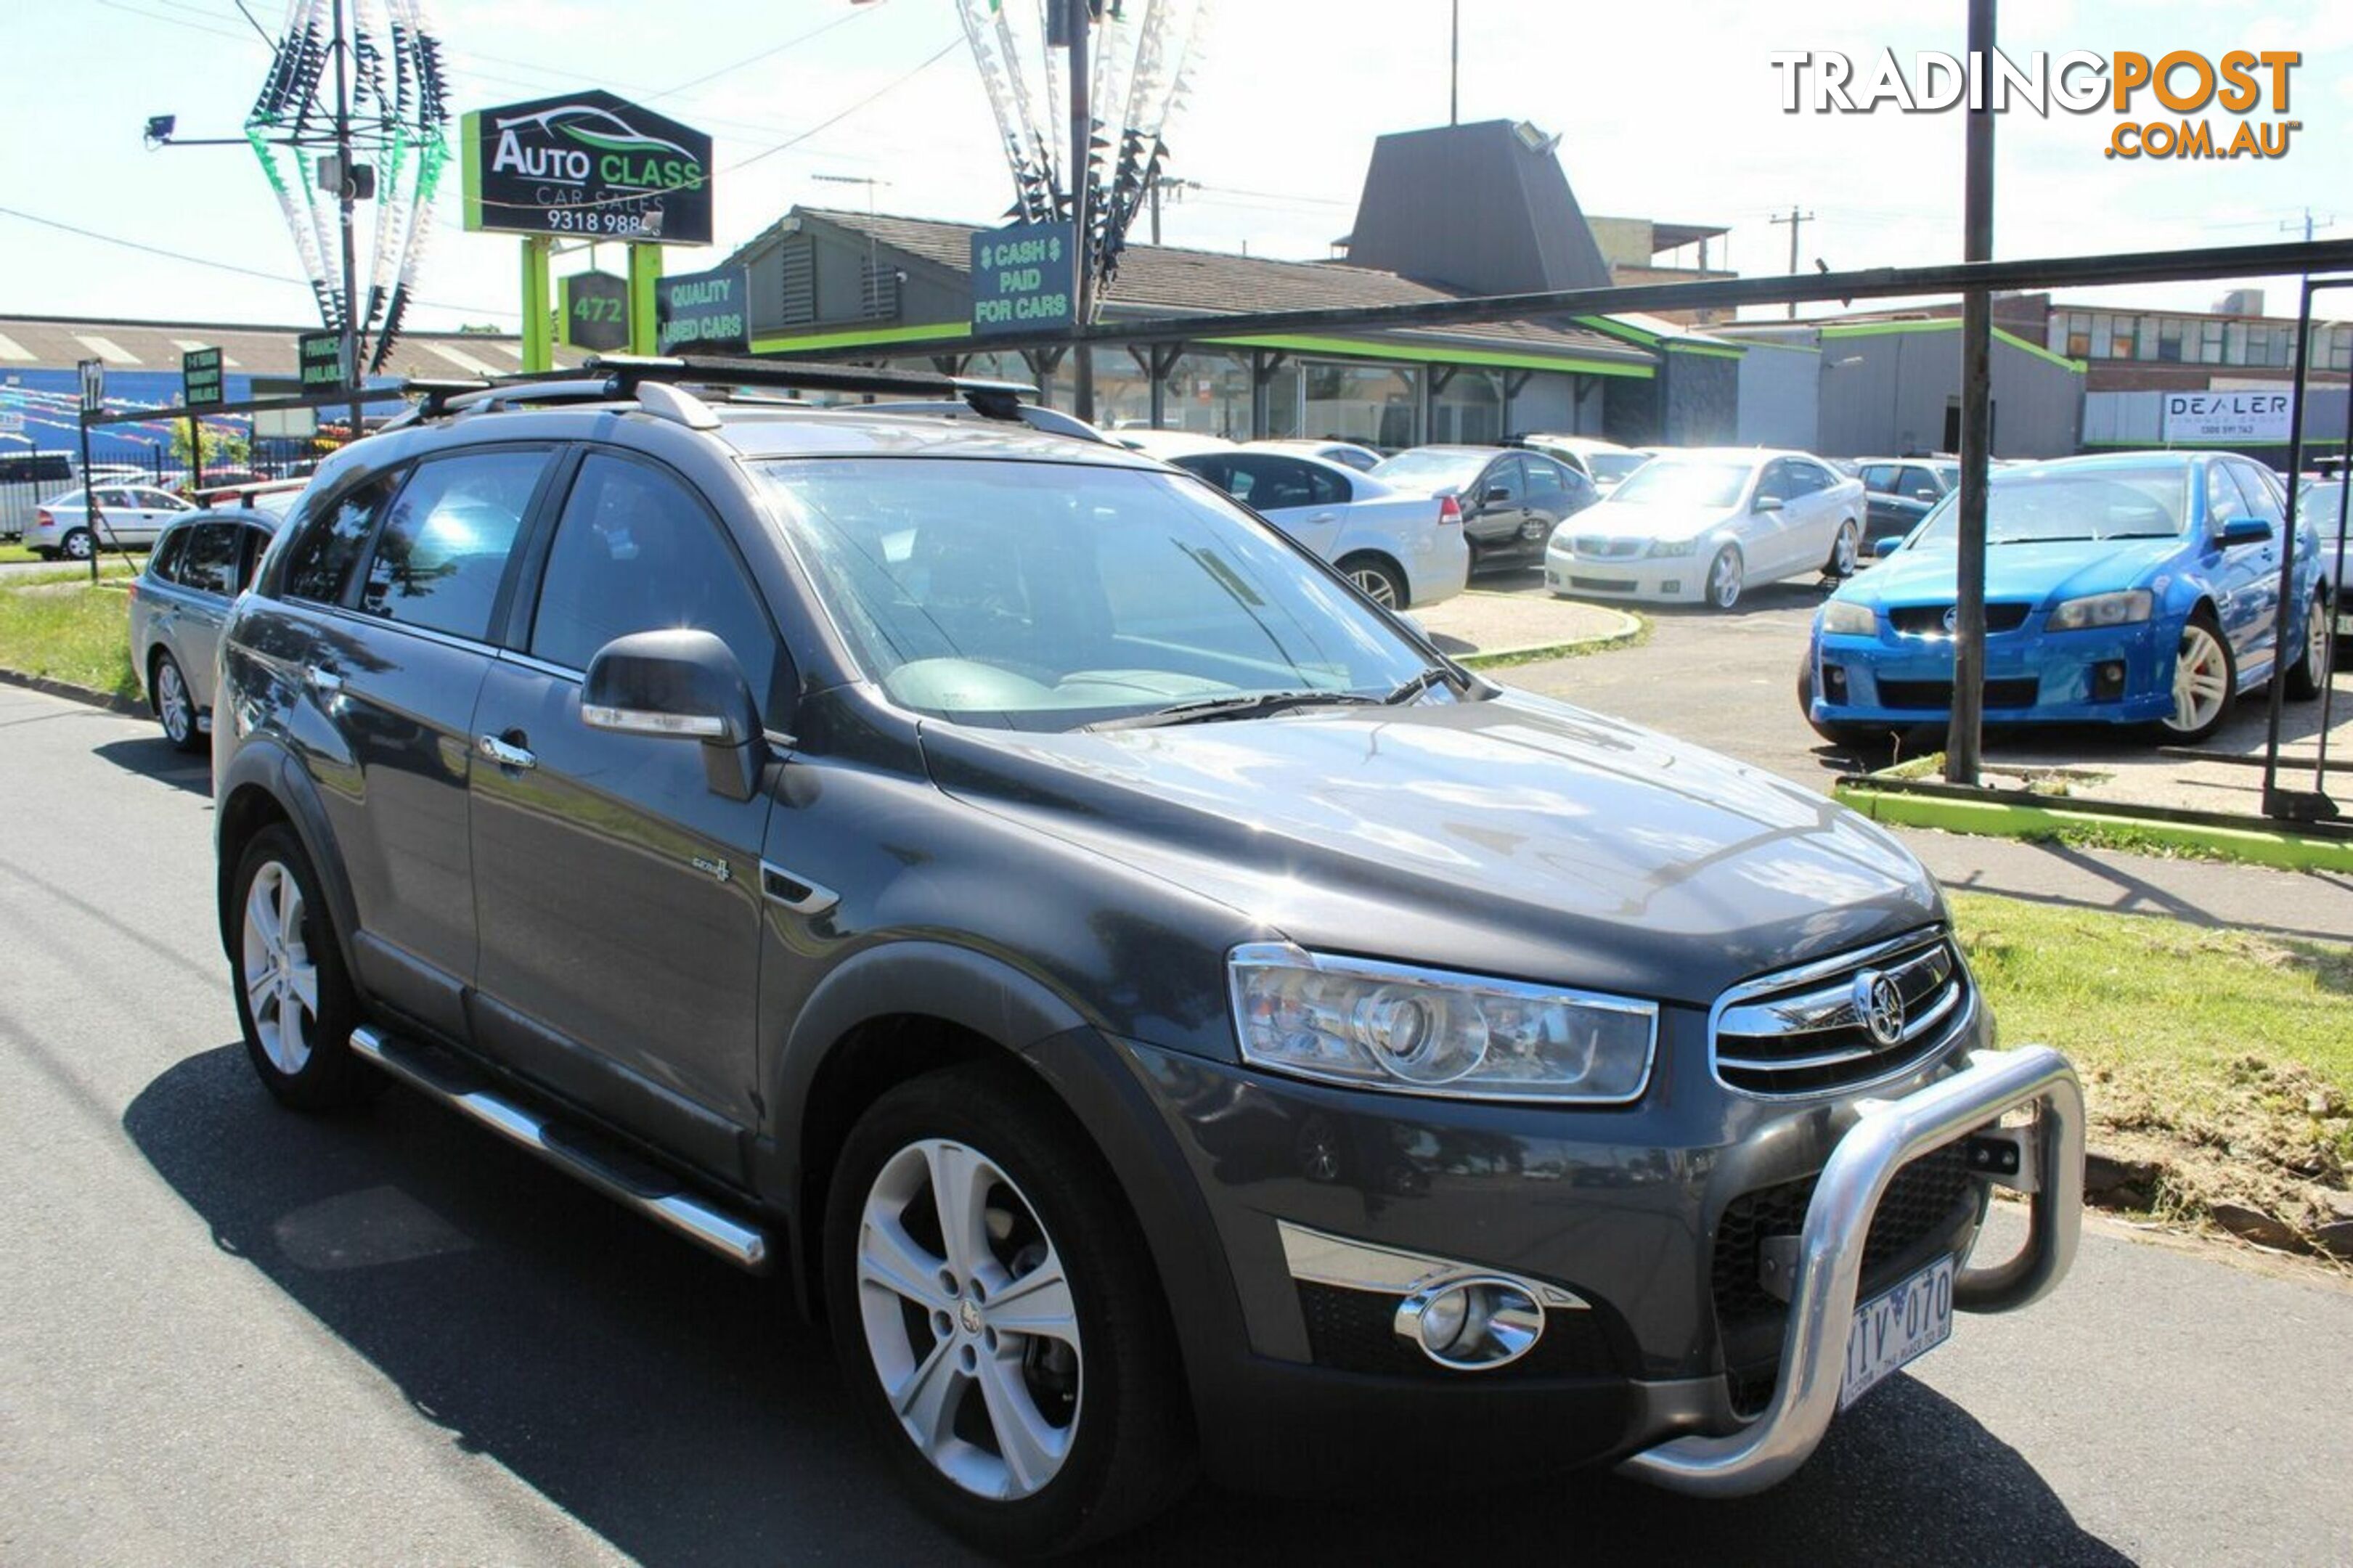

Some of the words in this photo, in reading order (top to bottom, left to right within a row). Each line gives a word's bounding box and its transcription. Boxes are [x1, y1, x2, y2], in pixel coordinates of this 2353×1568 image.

[492, 129, 590, 180] AUTO
[600, 155, 703, 190] CLASS
[536, 186, 582, 205] CAR
[595, 190, 665, 213] SALES
[547, 209, 599, 232] 9318
[995, 239, 1046, 266] CASH
[671, 279, 731, 308] QUALITY
[1000, 268, 1041, 293] PAID
[574, 296, 622, 323] 472
[975, 298, 1012, 324] FOR
[1016, 293, 1067, 319] CARS
[662, 319, 698, 343] USED
[701, 314, 743, 340] CARS
[2171, 396, 2287, 415] DEALER
[1906, 1270, 1950, 1340] 070
